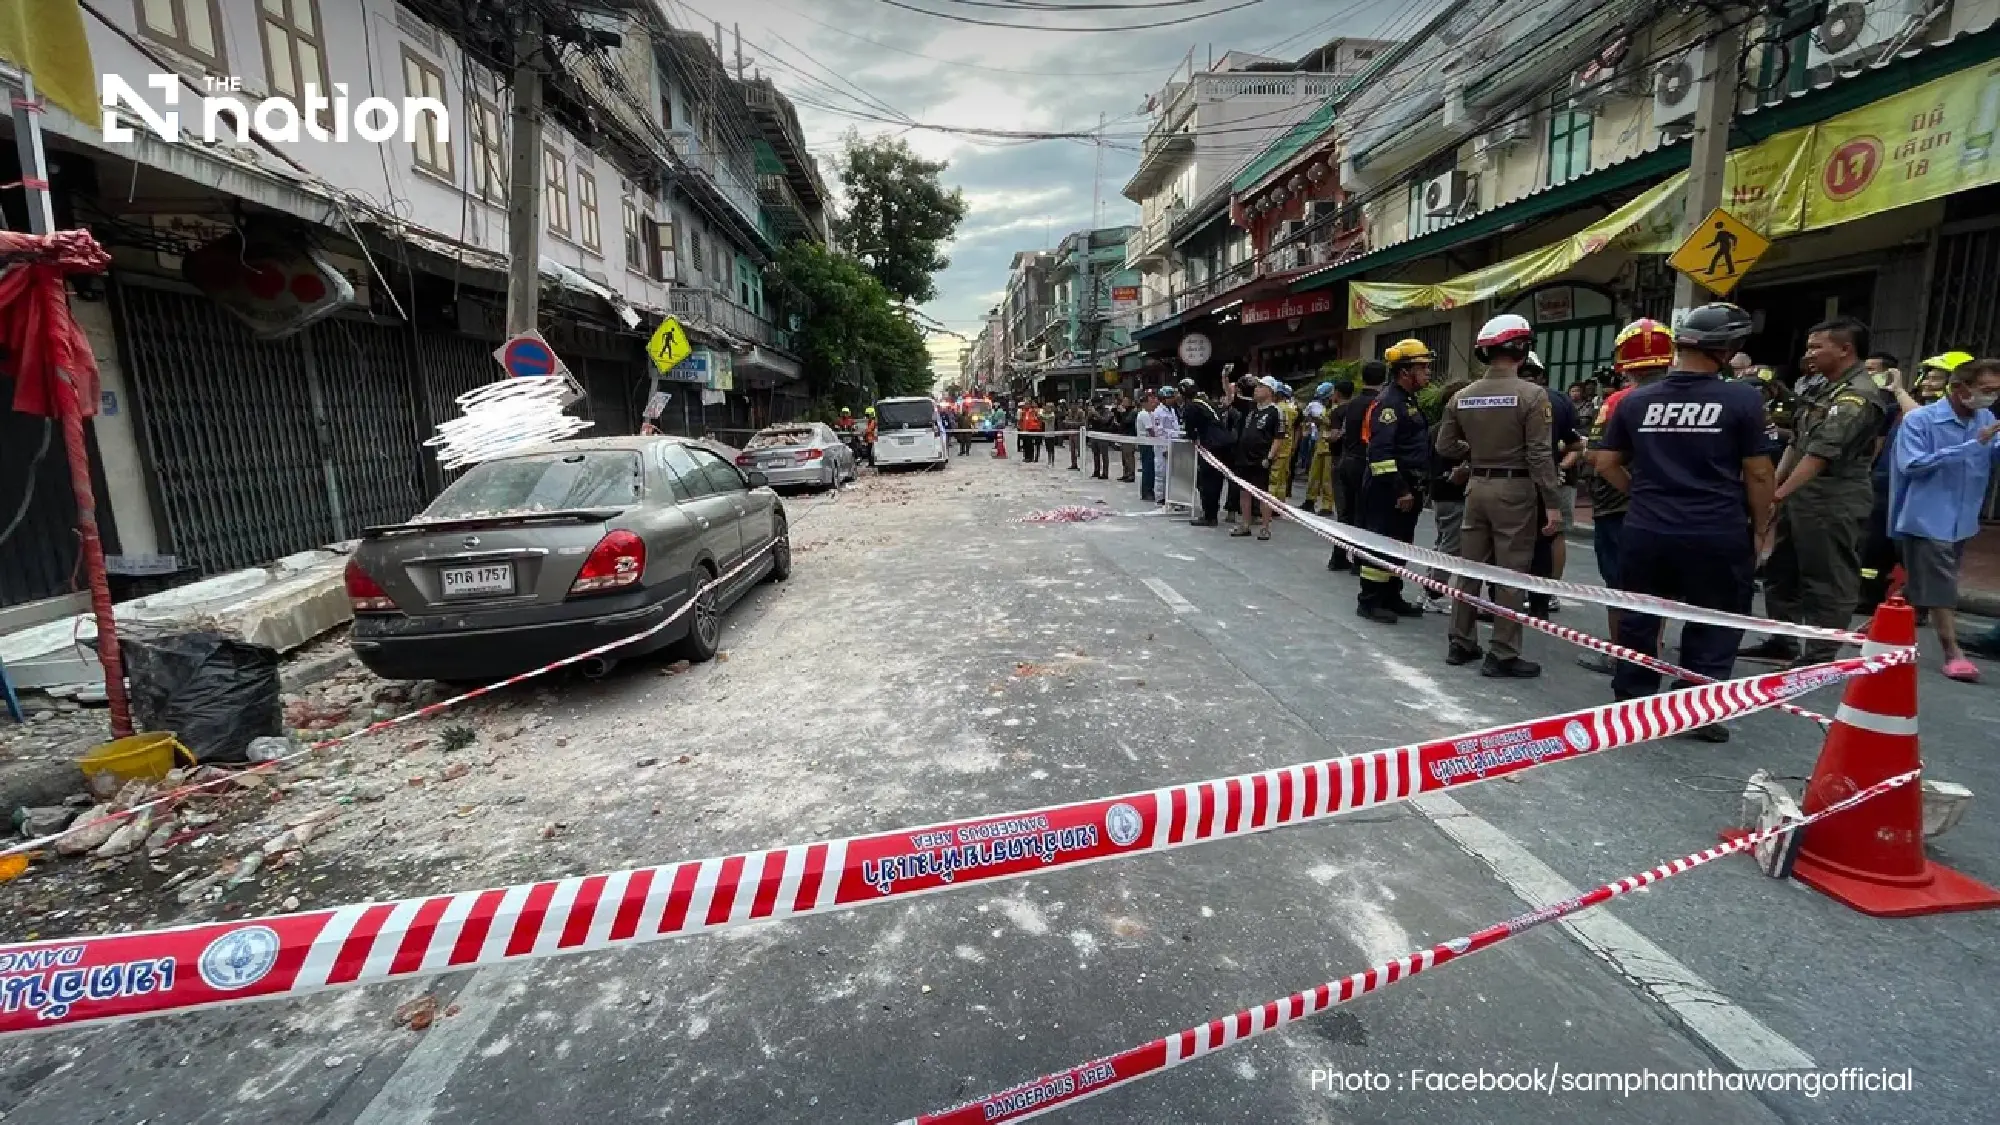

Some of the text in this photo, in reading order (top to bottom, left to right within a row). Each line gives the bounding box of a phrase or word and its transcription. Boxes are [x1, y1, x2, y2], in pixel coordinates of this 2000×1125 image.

[1460, 396, 1515, 407] TRAFFIC POLICE
[1642, 403, 1723, 427] BFRD
[477, 567, 508, 583] 1757
[911, 816, 1050, 849] DANGEROUS AREA
[862, 824, 1099, 894] เขตอันตรายห้ามเข้า
[982, 1063, 1116, 1120] DANGEROUS AREA
